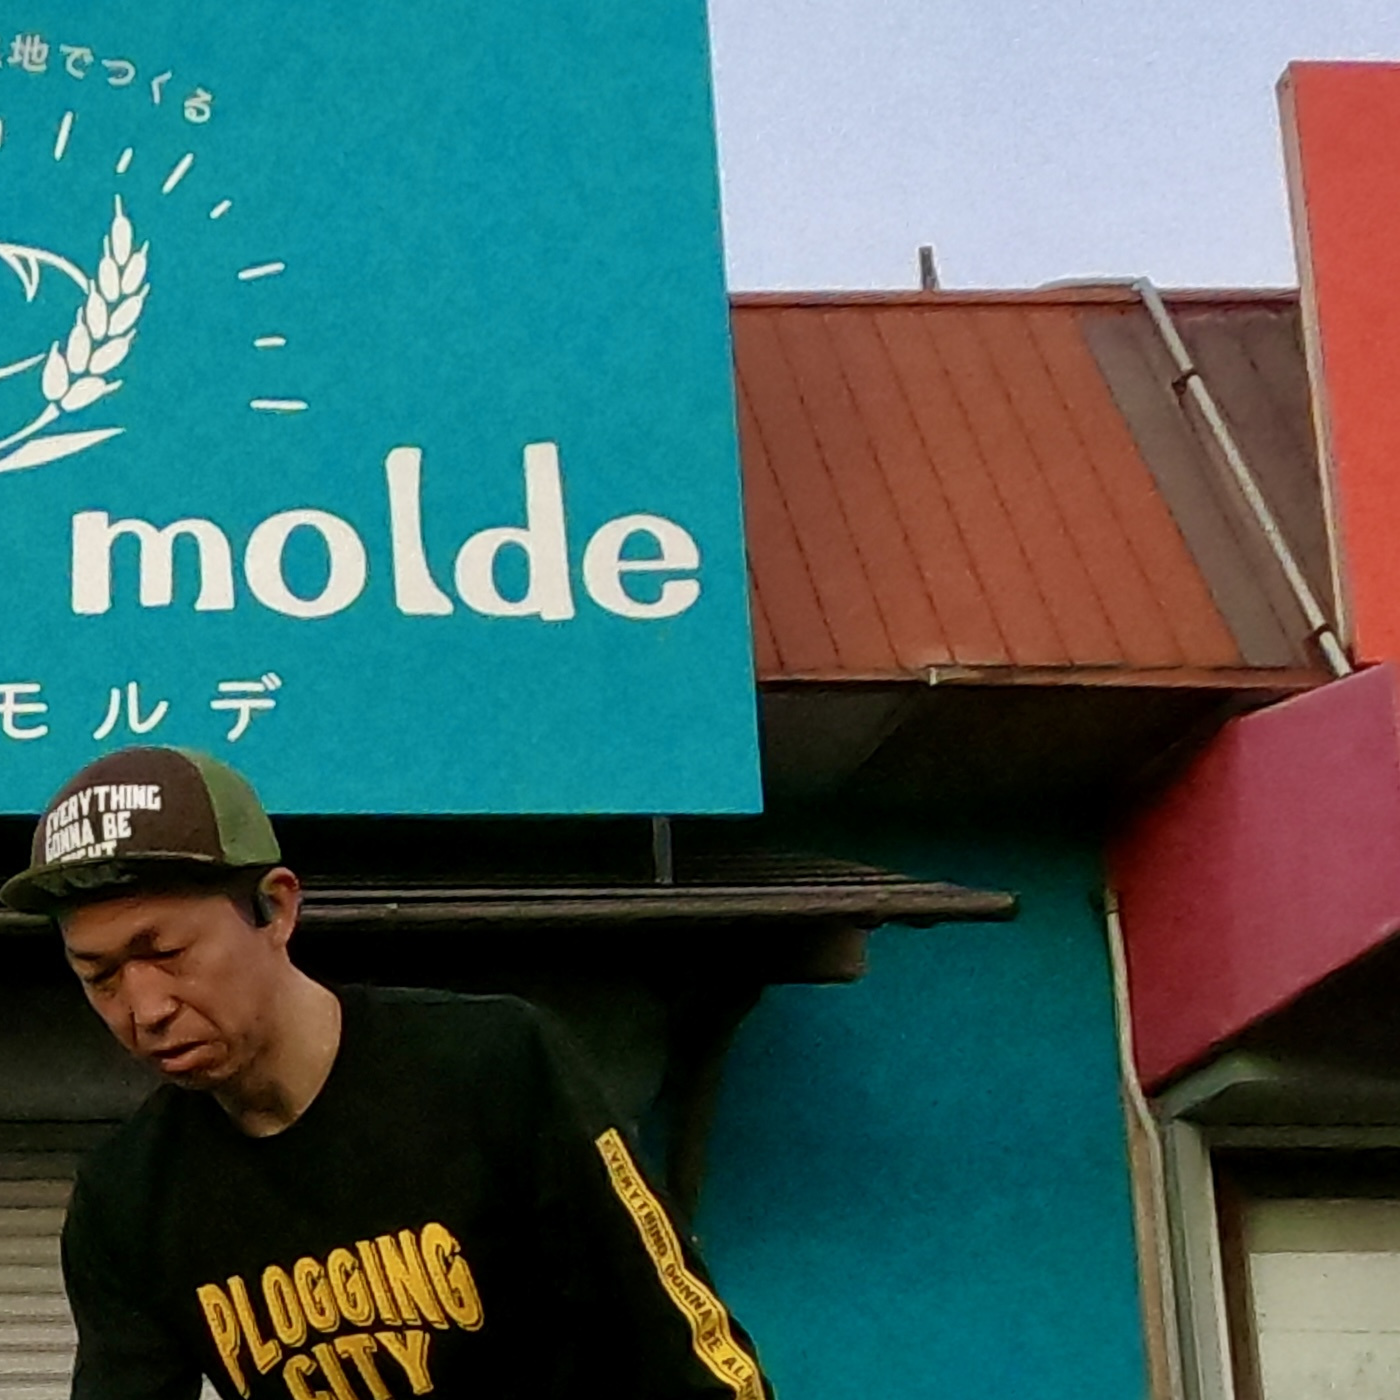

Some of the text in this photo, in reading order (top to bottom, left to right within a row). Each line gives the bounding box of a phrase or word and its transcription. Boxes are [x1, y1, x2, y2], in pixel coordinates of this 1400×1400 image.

[71, 441, 702, 622] molde
[45, 784, 162, 837] EVERYTHING
[102, 811, 132, 842] BE
[196, 1221, 485, 1400] PLOGGING
